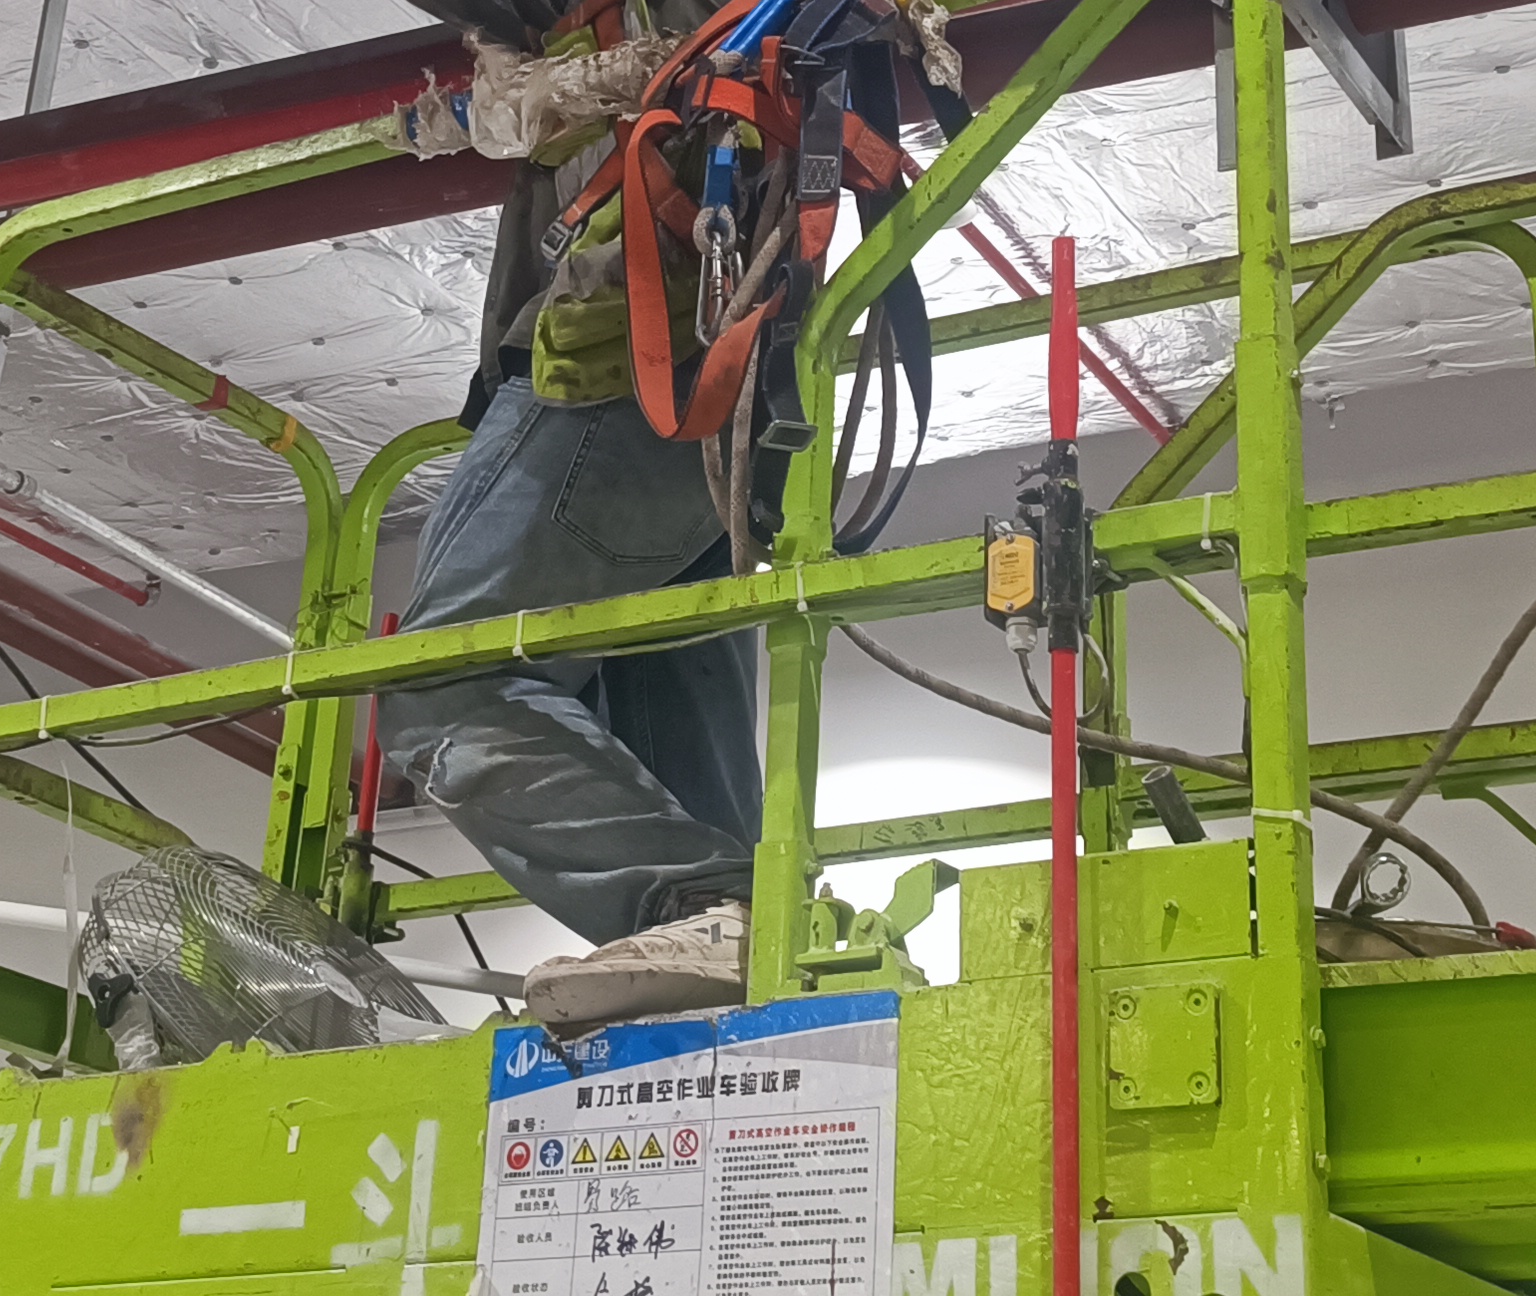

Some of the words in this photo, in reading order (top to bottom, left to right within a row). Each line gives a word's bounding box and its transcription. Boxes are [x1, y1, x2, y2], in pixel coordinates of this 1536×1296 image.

[576, 1069, 802, 1110] 剪刀式高空作业车验收牌
